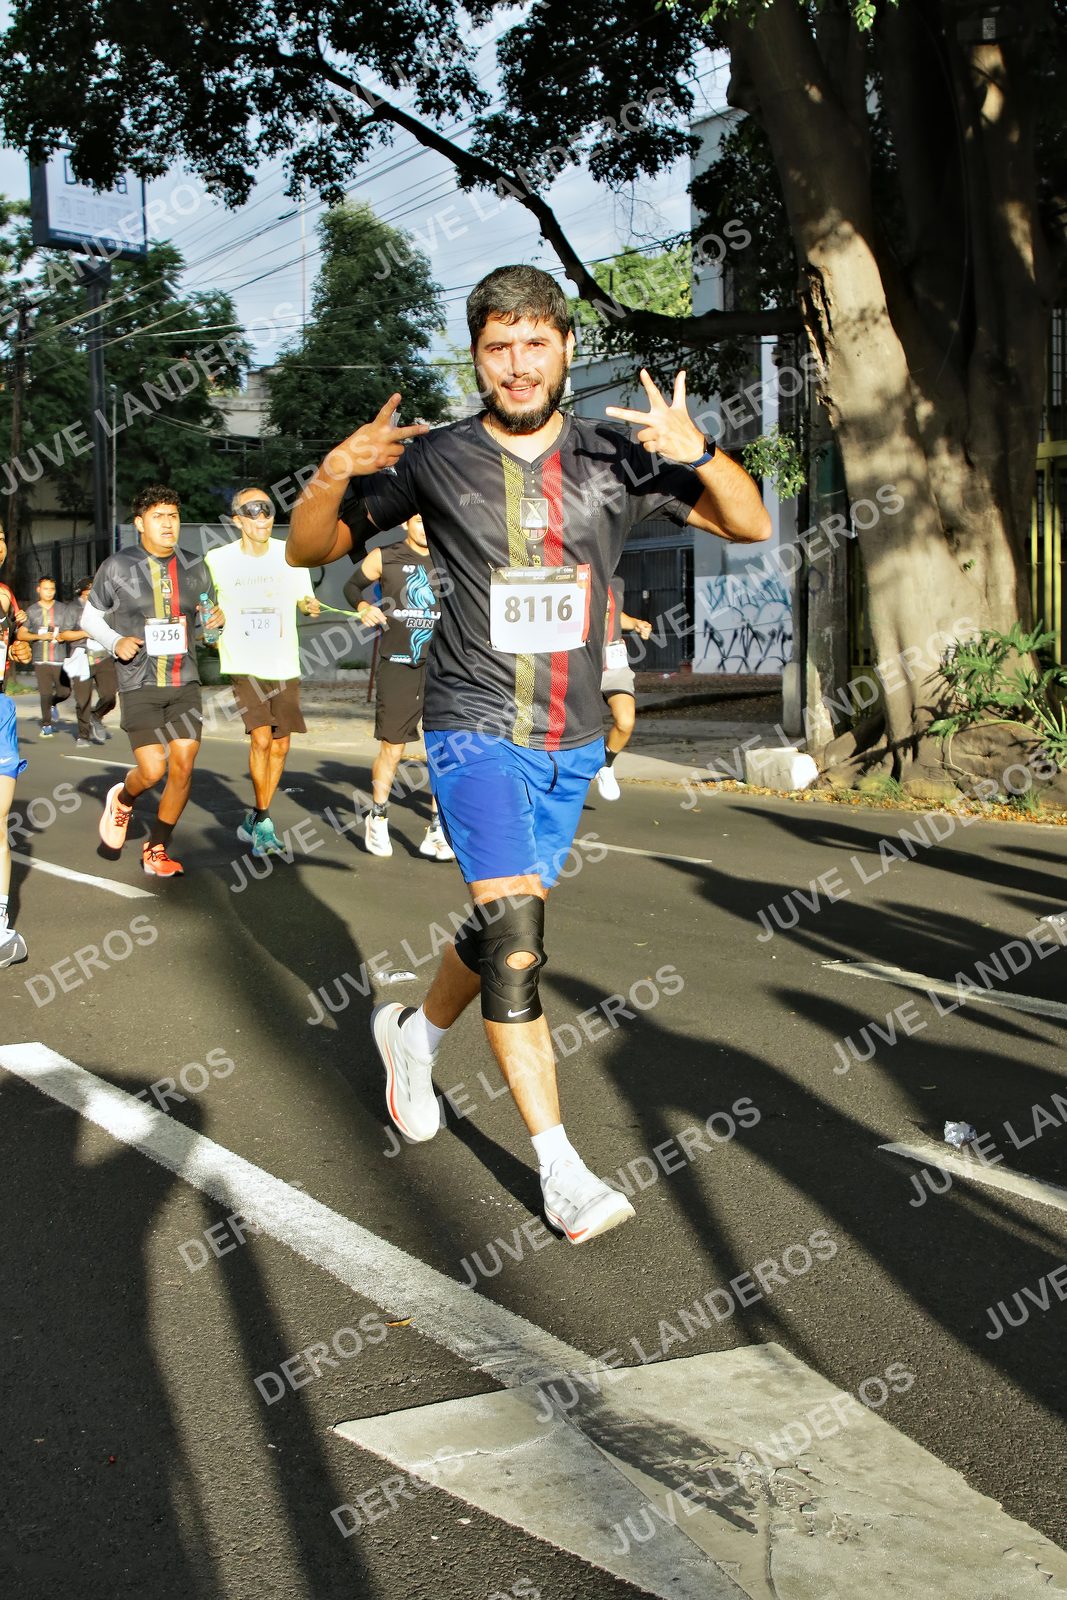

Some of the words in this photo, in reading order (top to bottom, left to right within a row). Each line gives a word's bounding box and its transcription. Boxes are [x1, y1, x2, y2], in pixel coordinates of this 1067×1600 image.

[504, 594, 573, 623] 8116
[250, 619, 270, 630] 128
[407, 618, 435, 628] RUN
[152, 629, 180, 641] 9256
